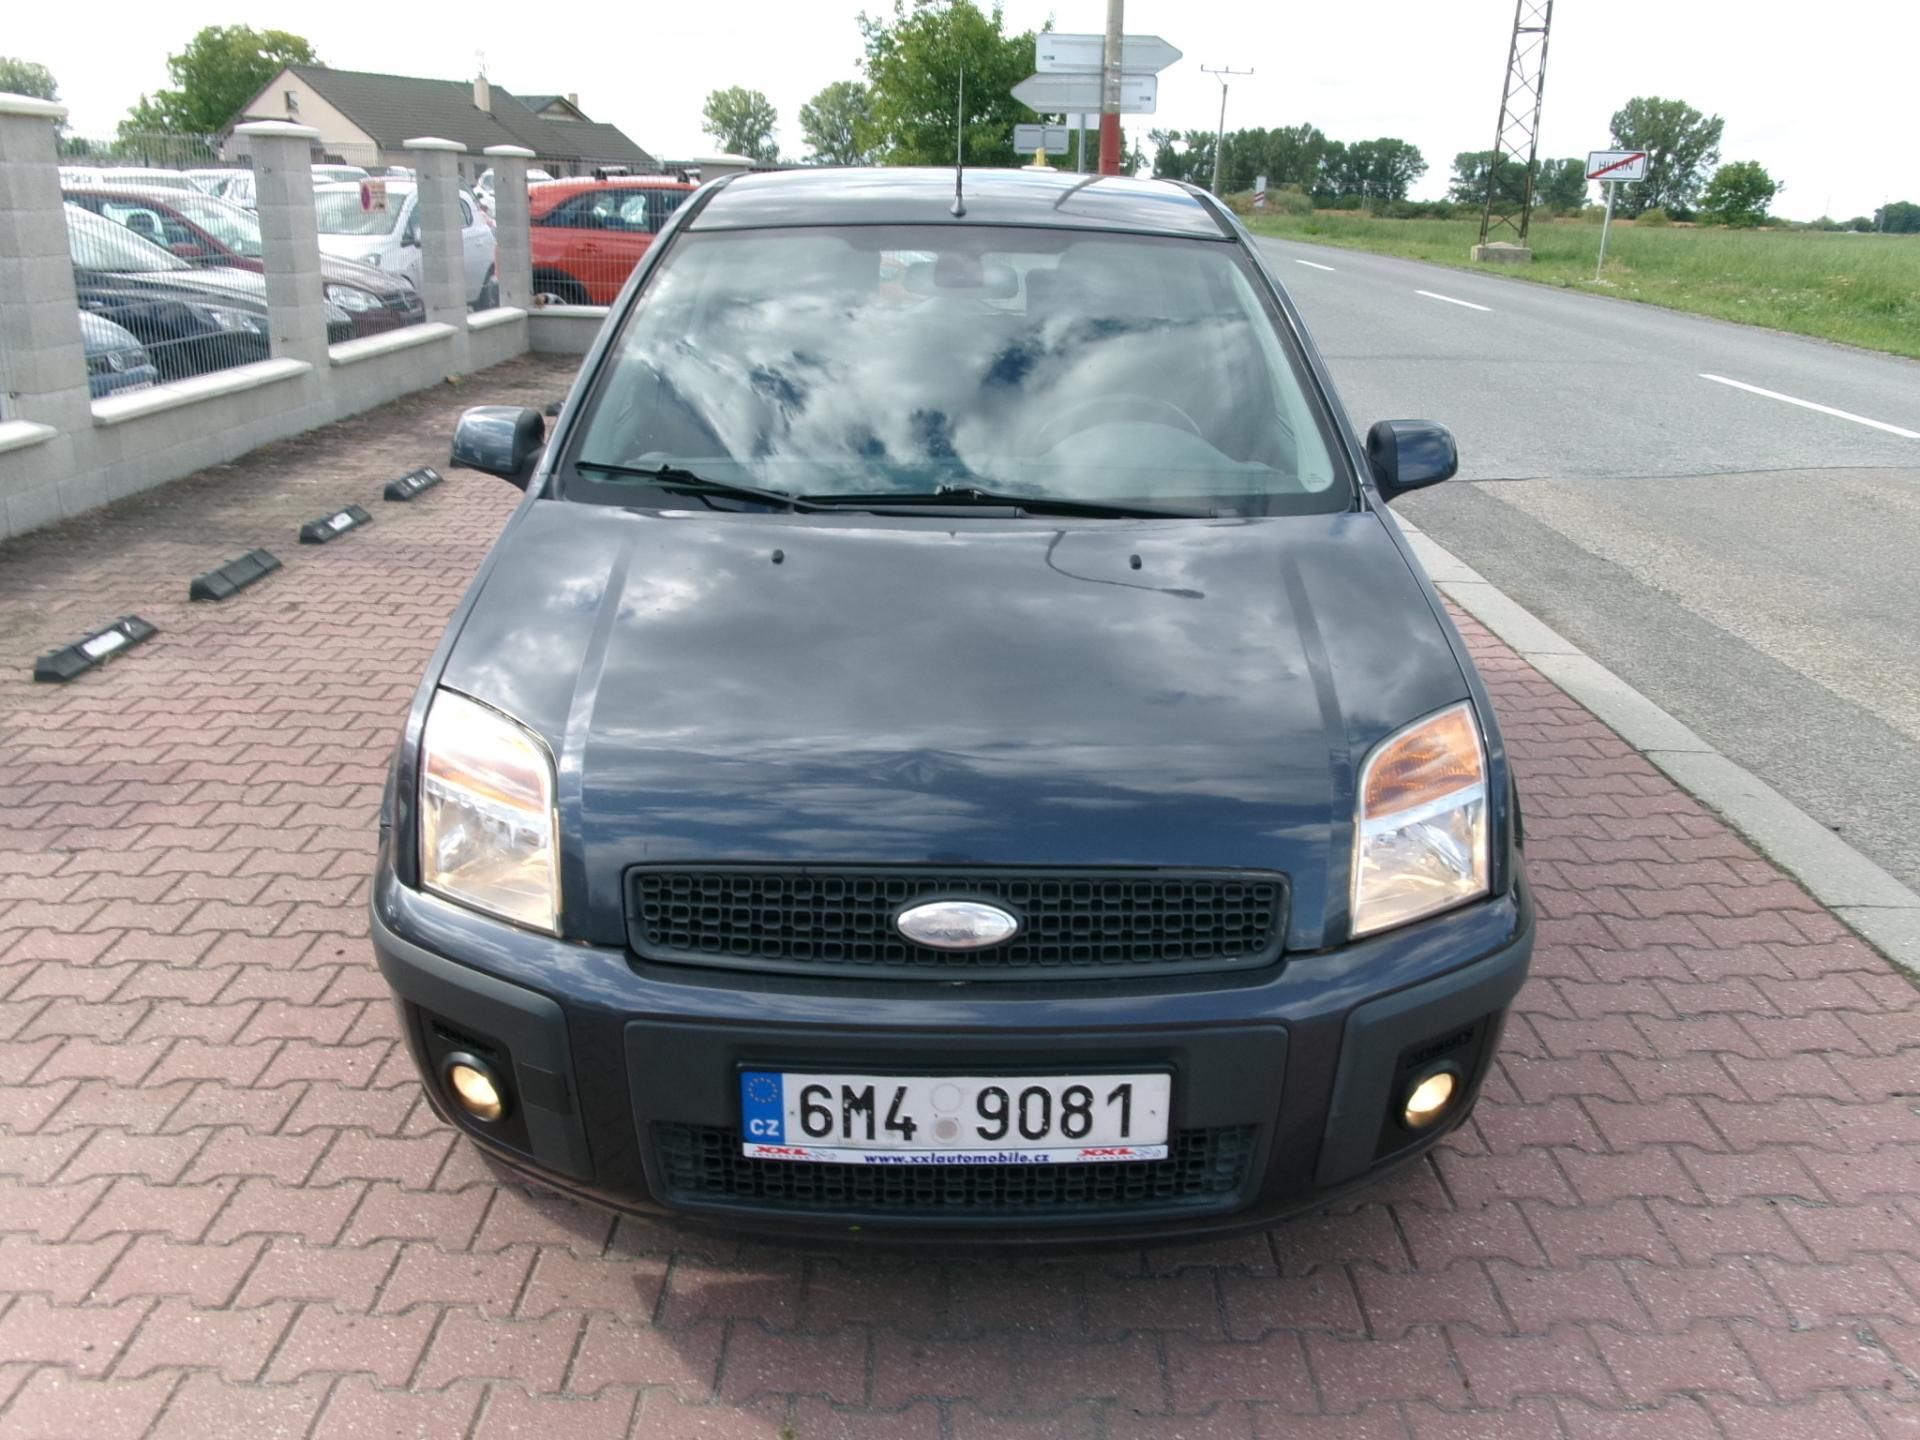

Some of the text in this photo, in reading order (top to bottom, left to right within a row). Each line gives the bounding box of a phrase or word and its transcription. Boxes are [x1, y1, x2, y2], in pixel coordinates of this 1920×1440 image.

[799, 1083, 1132, 1141] 6M4 9081
[750, 1118, 779, 1136] CZ
[754, 1146, 808, 1155] XXL
[1079, 1148, 1135, 1156] XXL
[864, 1153, 1050, 1164] www.xxlautomobile.cz
